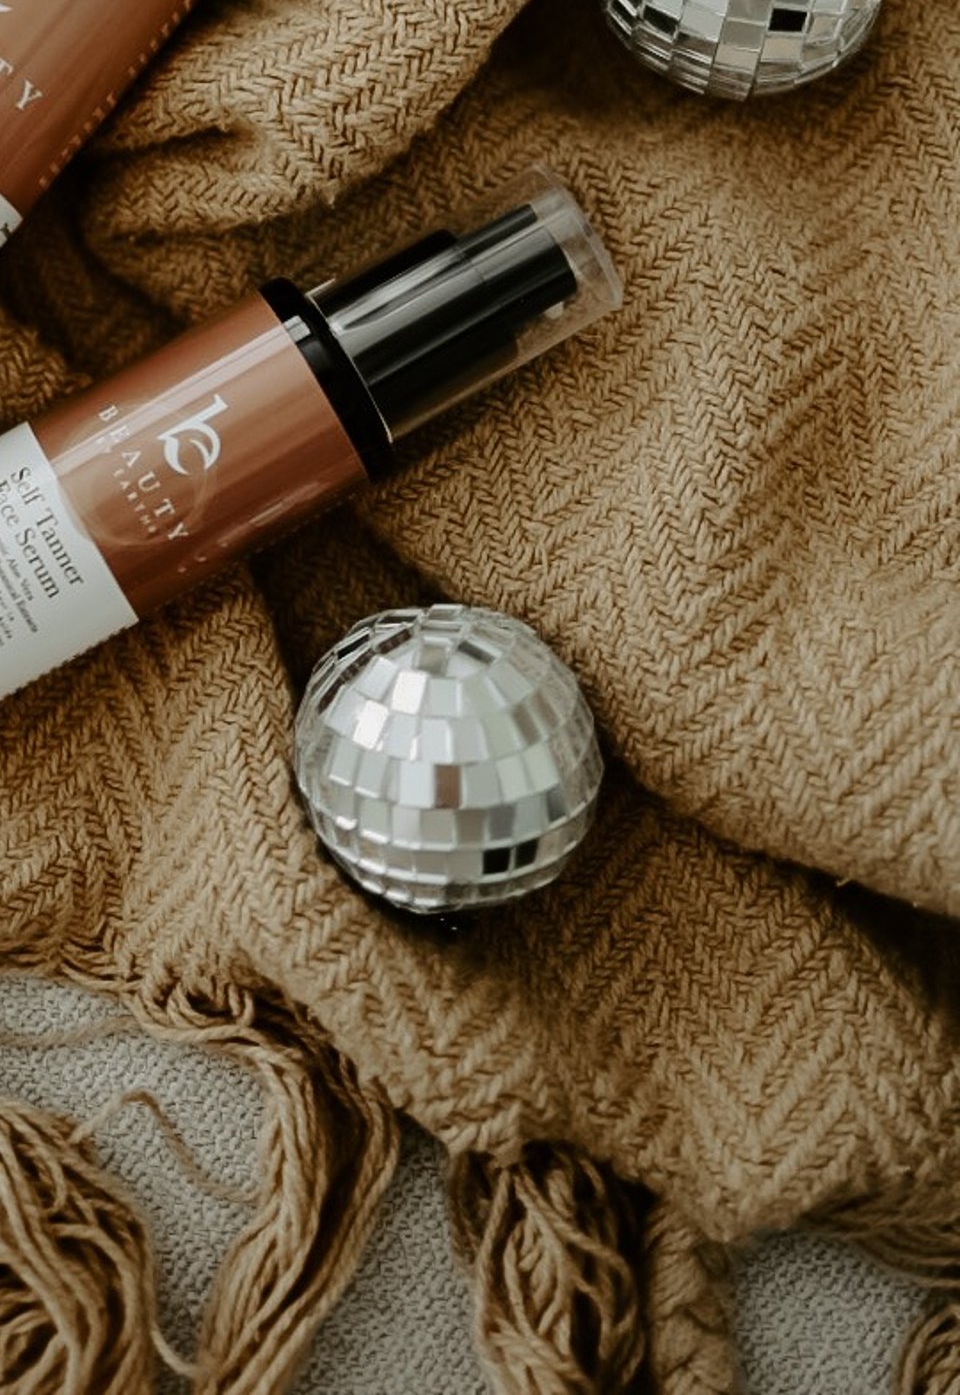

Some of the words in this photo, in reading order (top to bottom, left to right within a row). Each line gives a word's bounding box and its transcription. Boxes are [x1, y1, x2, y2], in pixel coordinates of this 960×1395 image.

[10, 466, 45, 506] Self
[34, 507, 86, 586] Tanner
[98, 405, 189, 540] BEAUTY
[14, 527, 62, 599] Serum
